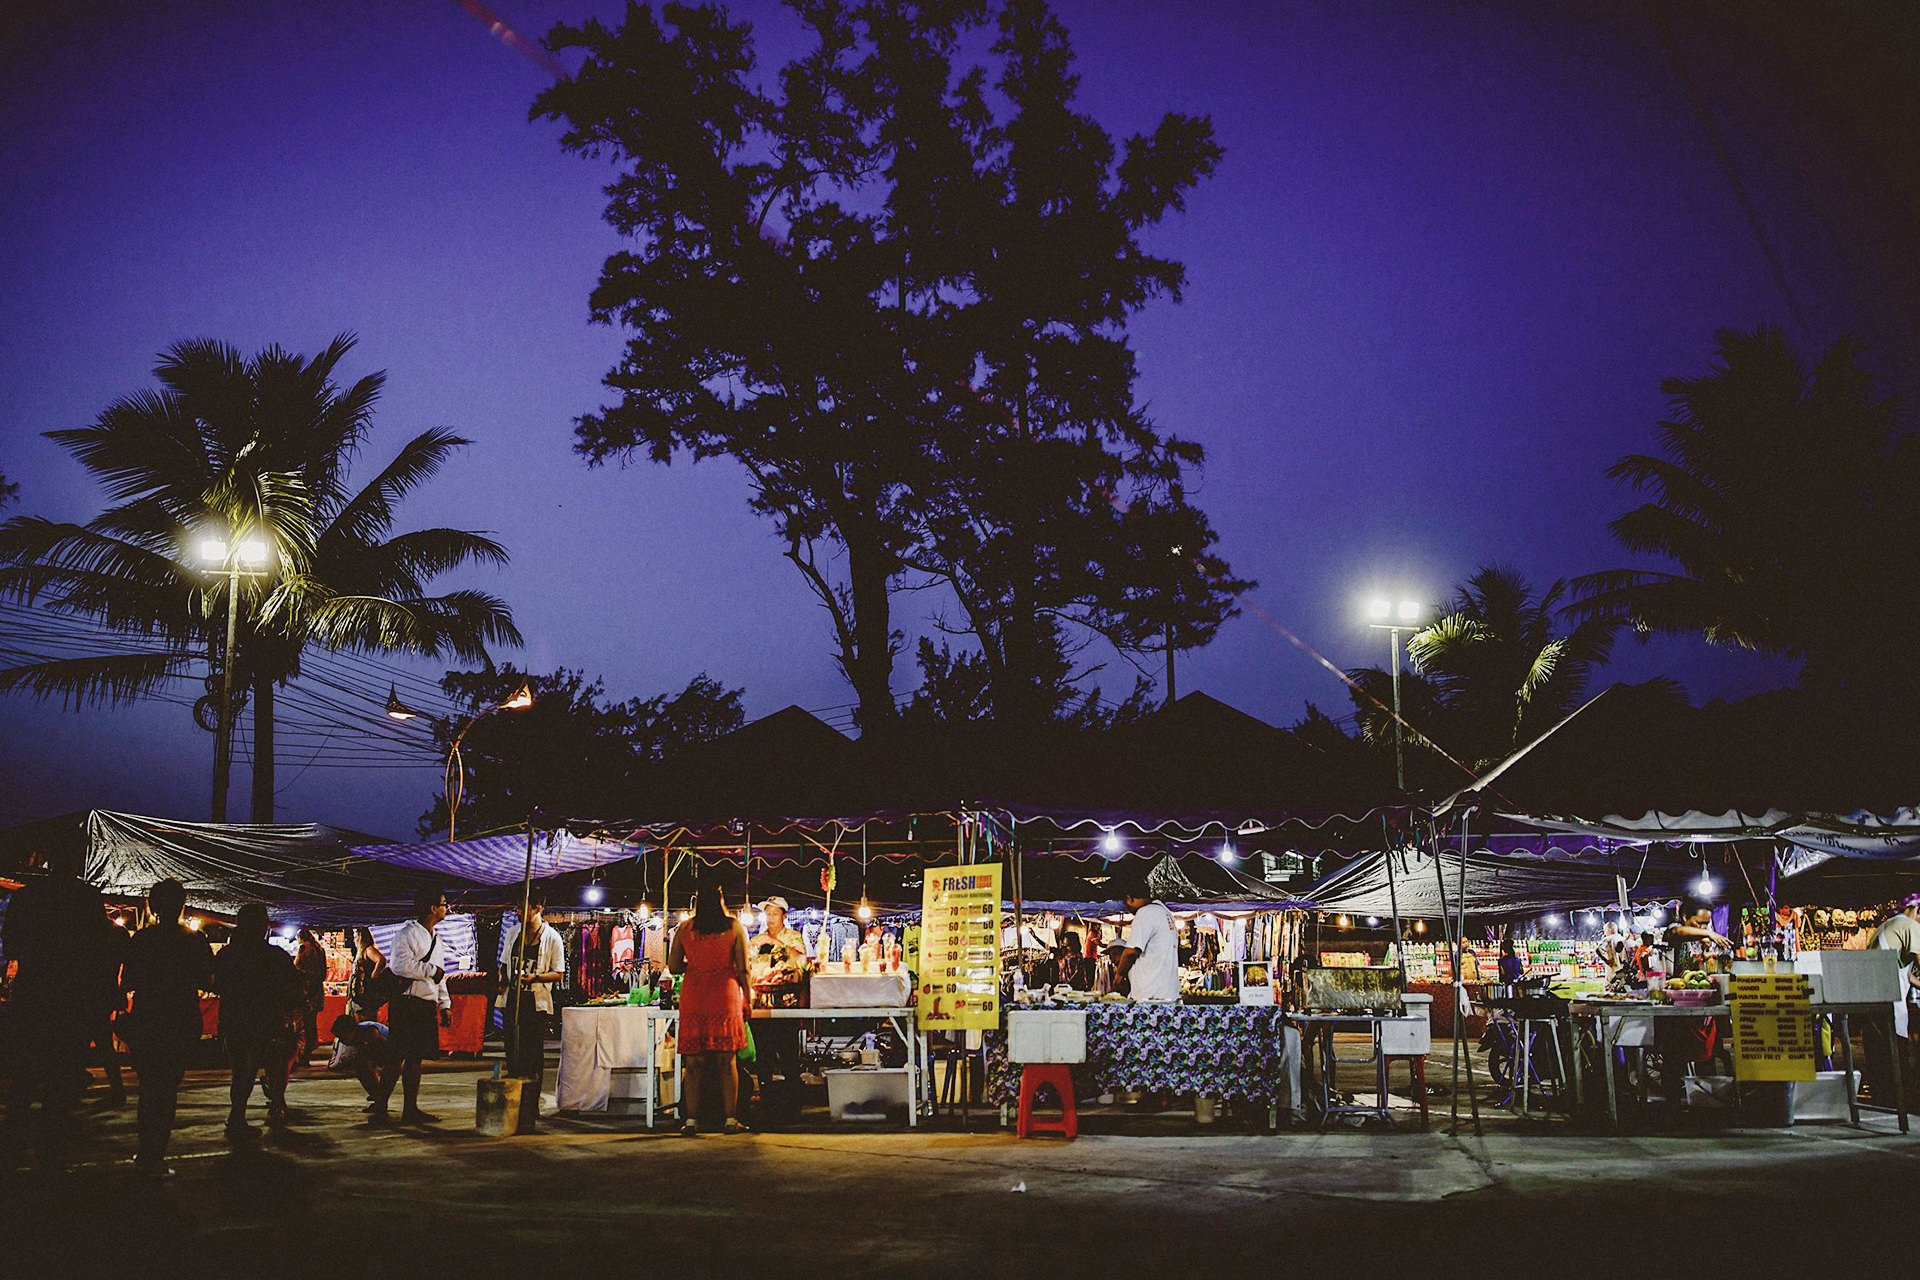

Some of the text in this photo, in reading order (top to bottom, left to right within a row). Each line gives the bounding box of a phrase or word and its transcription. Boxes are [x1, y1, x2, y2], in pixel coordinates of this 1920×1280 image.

[943, 875, 975, 891] FRESH
[950, 906, 958, 916] 70
[982, 903, 993, 914] 60
[948, 922, 959, 931] 60
[949, 936, 959, 946] 60
[983, 934, 994, 945] 60
[947, 951, 958, 961] 60
[946, 967, 956, 977] 60
[946, 983, 957, 993] 60
[982, 1001, 993, 1011] 60
